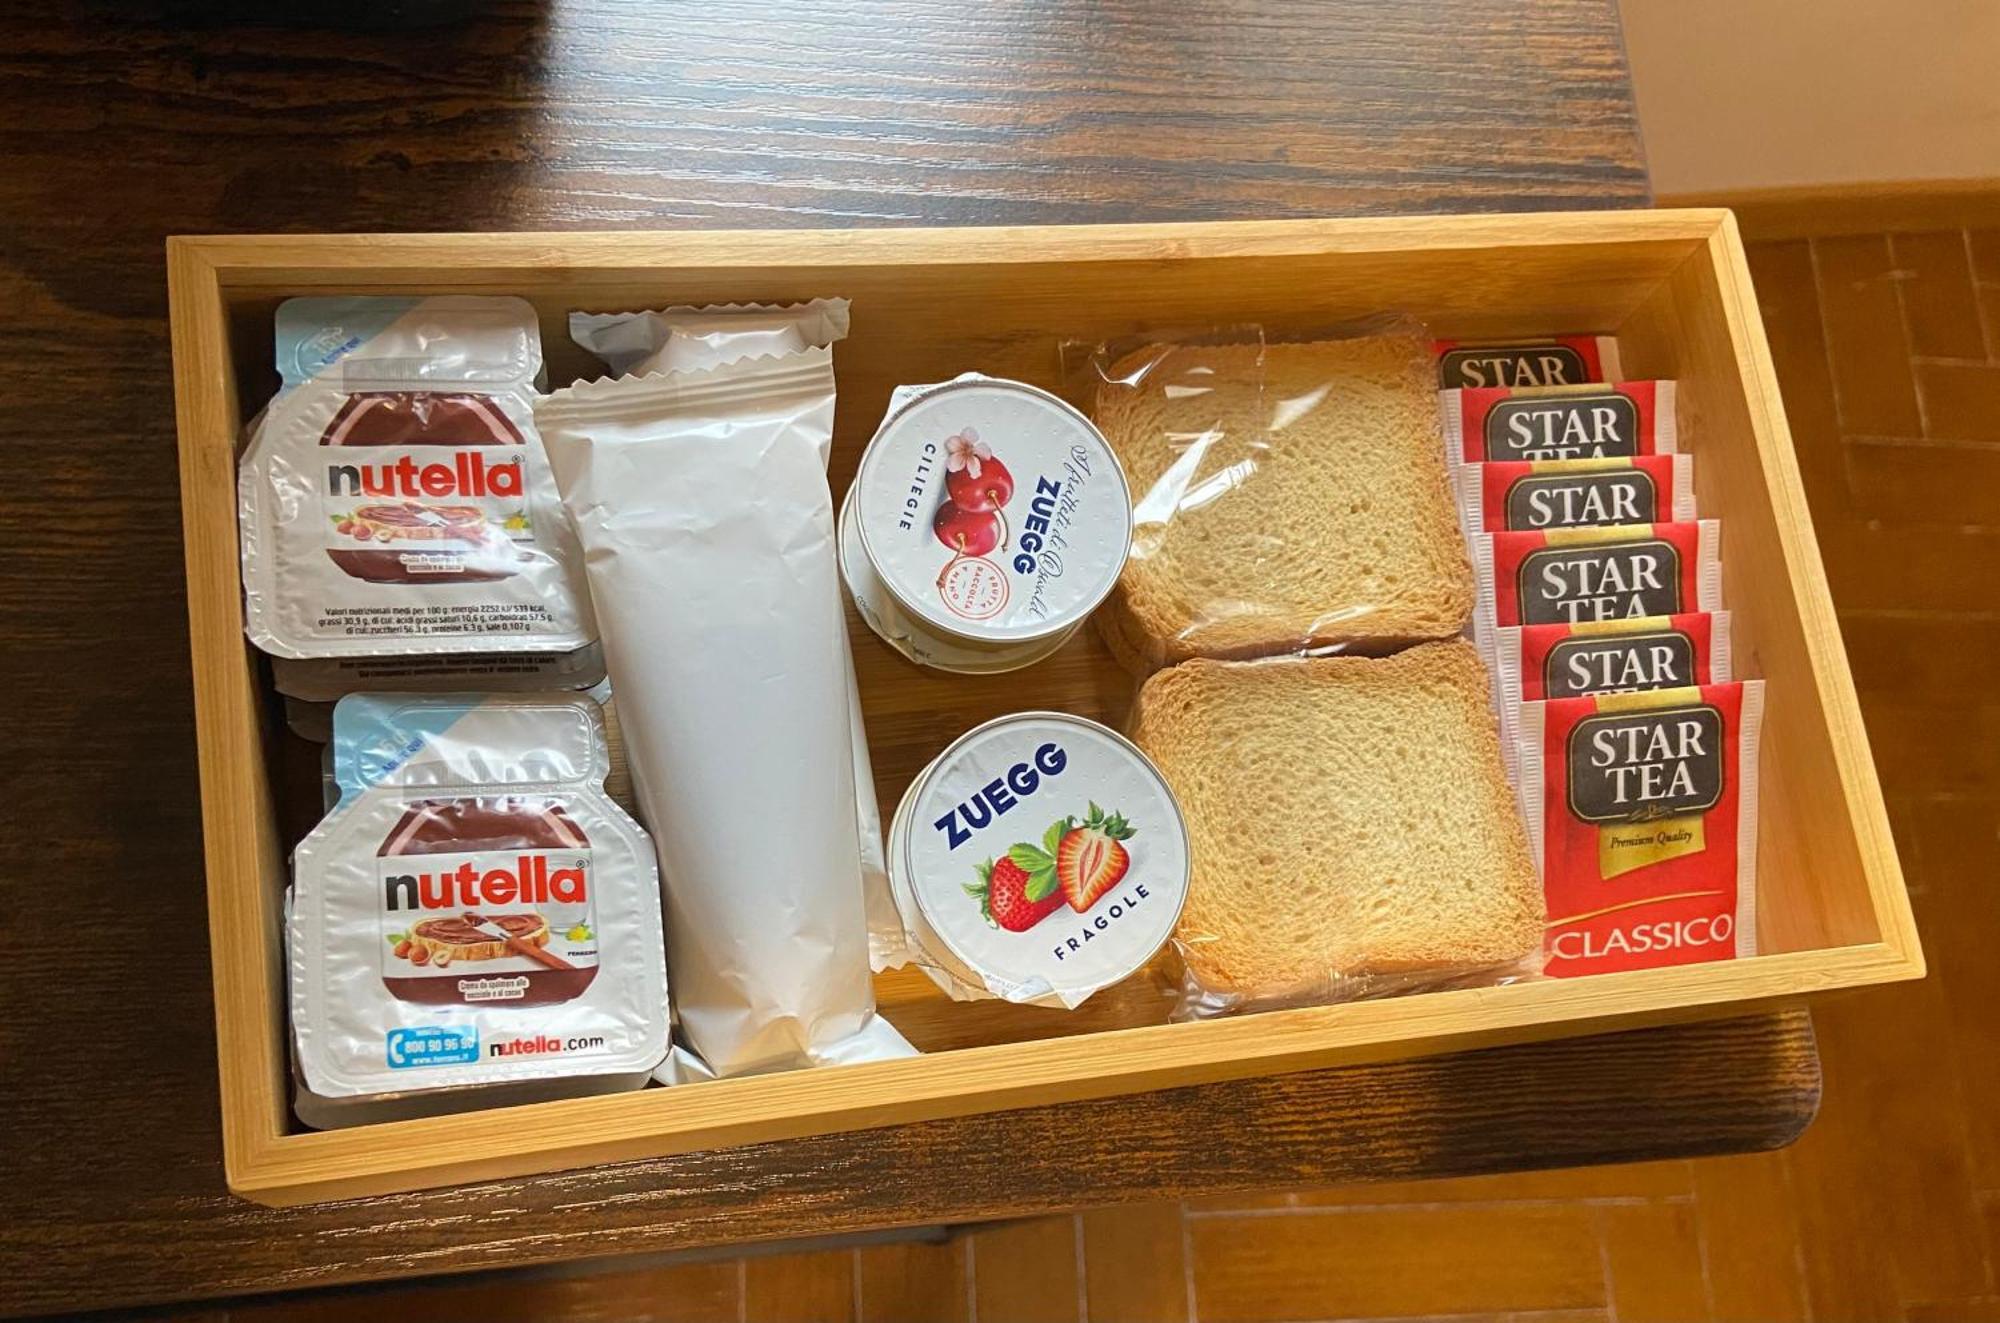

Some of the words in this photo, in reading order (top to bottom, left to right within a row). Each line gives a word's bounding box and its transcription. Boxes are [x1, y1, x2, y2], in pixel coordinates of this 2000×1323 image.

[1460, 355, 1566, 387] STAR
[1507, 407, 1622, 449] STAR
[899, 442, 937, 531] CILIEGIE
[1527, 483, 1642, 527] STAR
[1013, 475, 1062, 576] ZUEGG
[1540, 554, 1663, 600] STAR
[1567, 645, 1679, 690] STAR
[1590, 720, 1706, 767] STAR
[934, 743, 1067, 851] ZUEGG
[1604, 760, 1699, 804] TEA
[1611, 834, 1654, 849] Premium
[1656, 828, 1693, 845] Quality
[1053, 884, 1150, 961] FRAGOLE
[1551, 913, 1733, 960] CLASSICO
[490, 1035, 604, 1057] nutella.com
